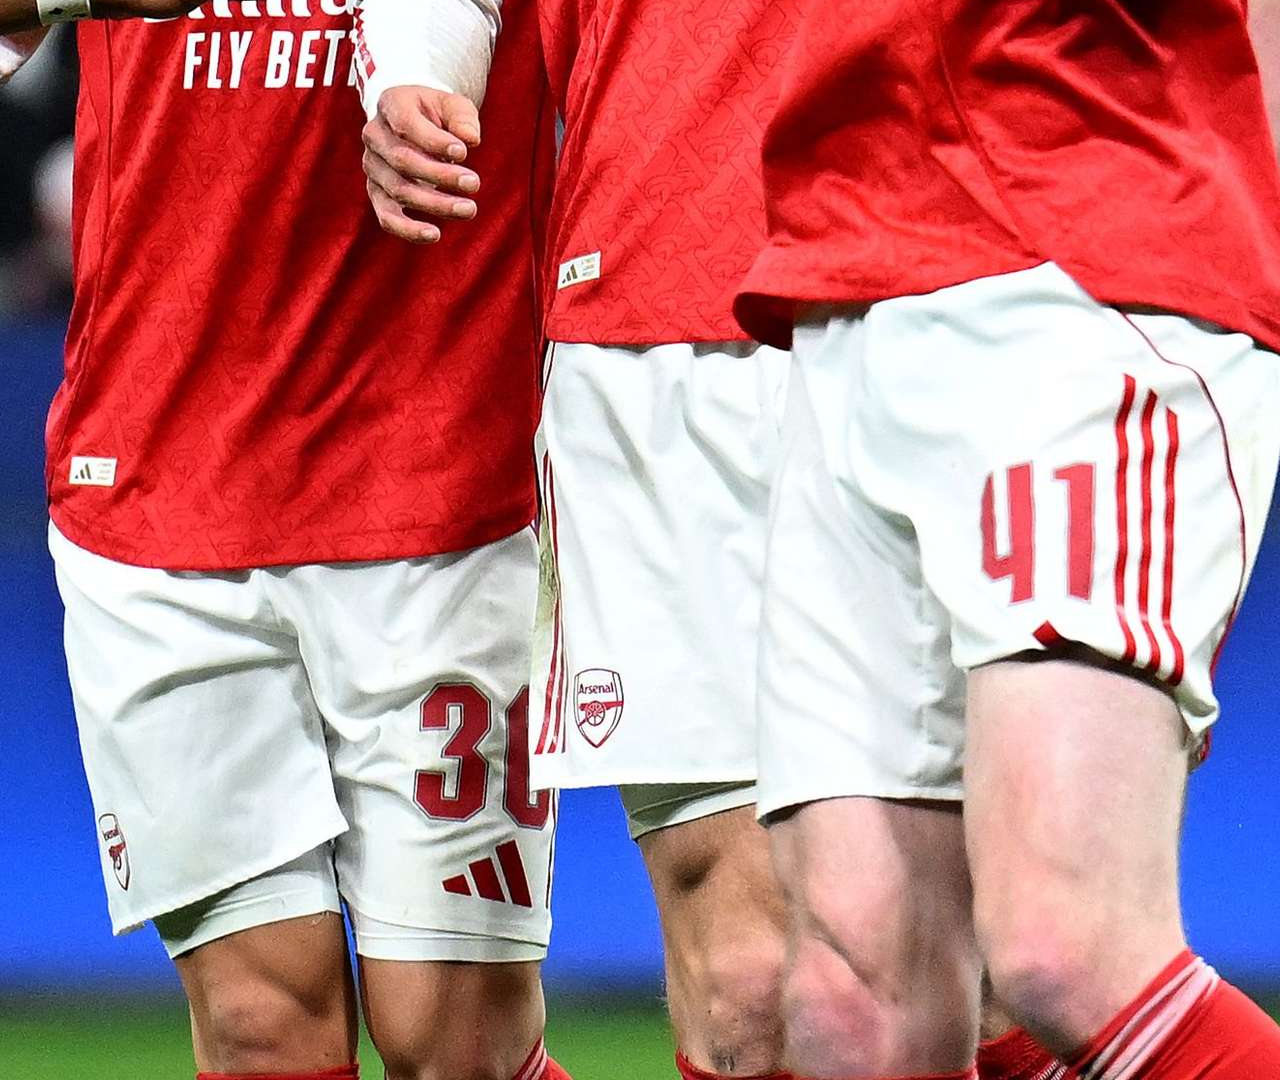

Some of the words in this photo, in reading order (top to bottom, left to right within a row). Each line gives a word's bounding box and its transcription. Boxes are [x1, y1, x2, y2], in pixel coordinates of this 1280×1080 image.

[183, 31, 253, 89] FLY
[980, 461, 1096, 607] 41
[578, 682, 614, 695] Arsenal
